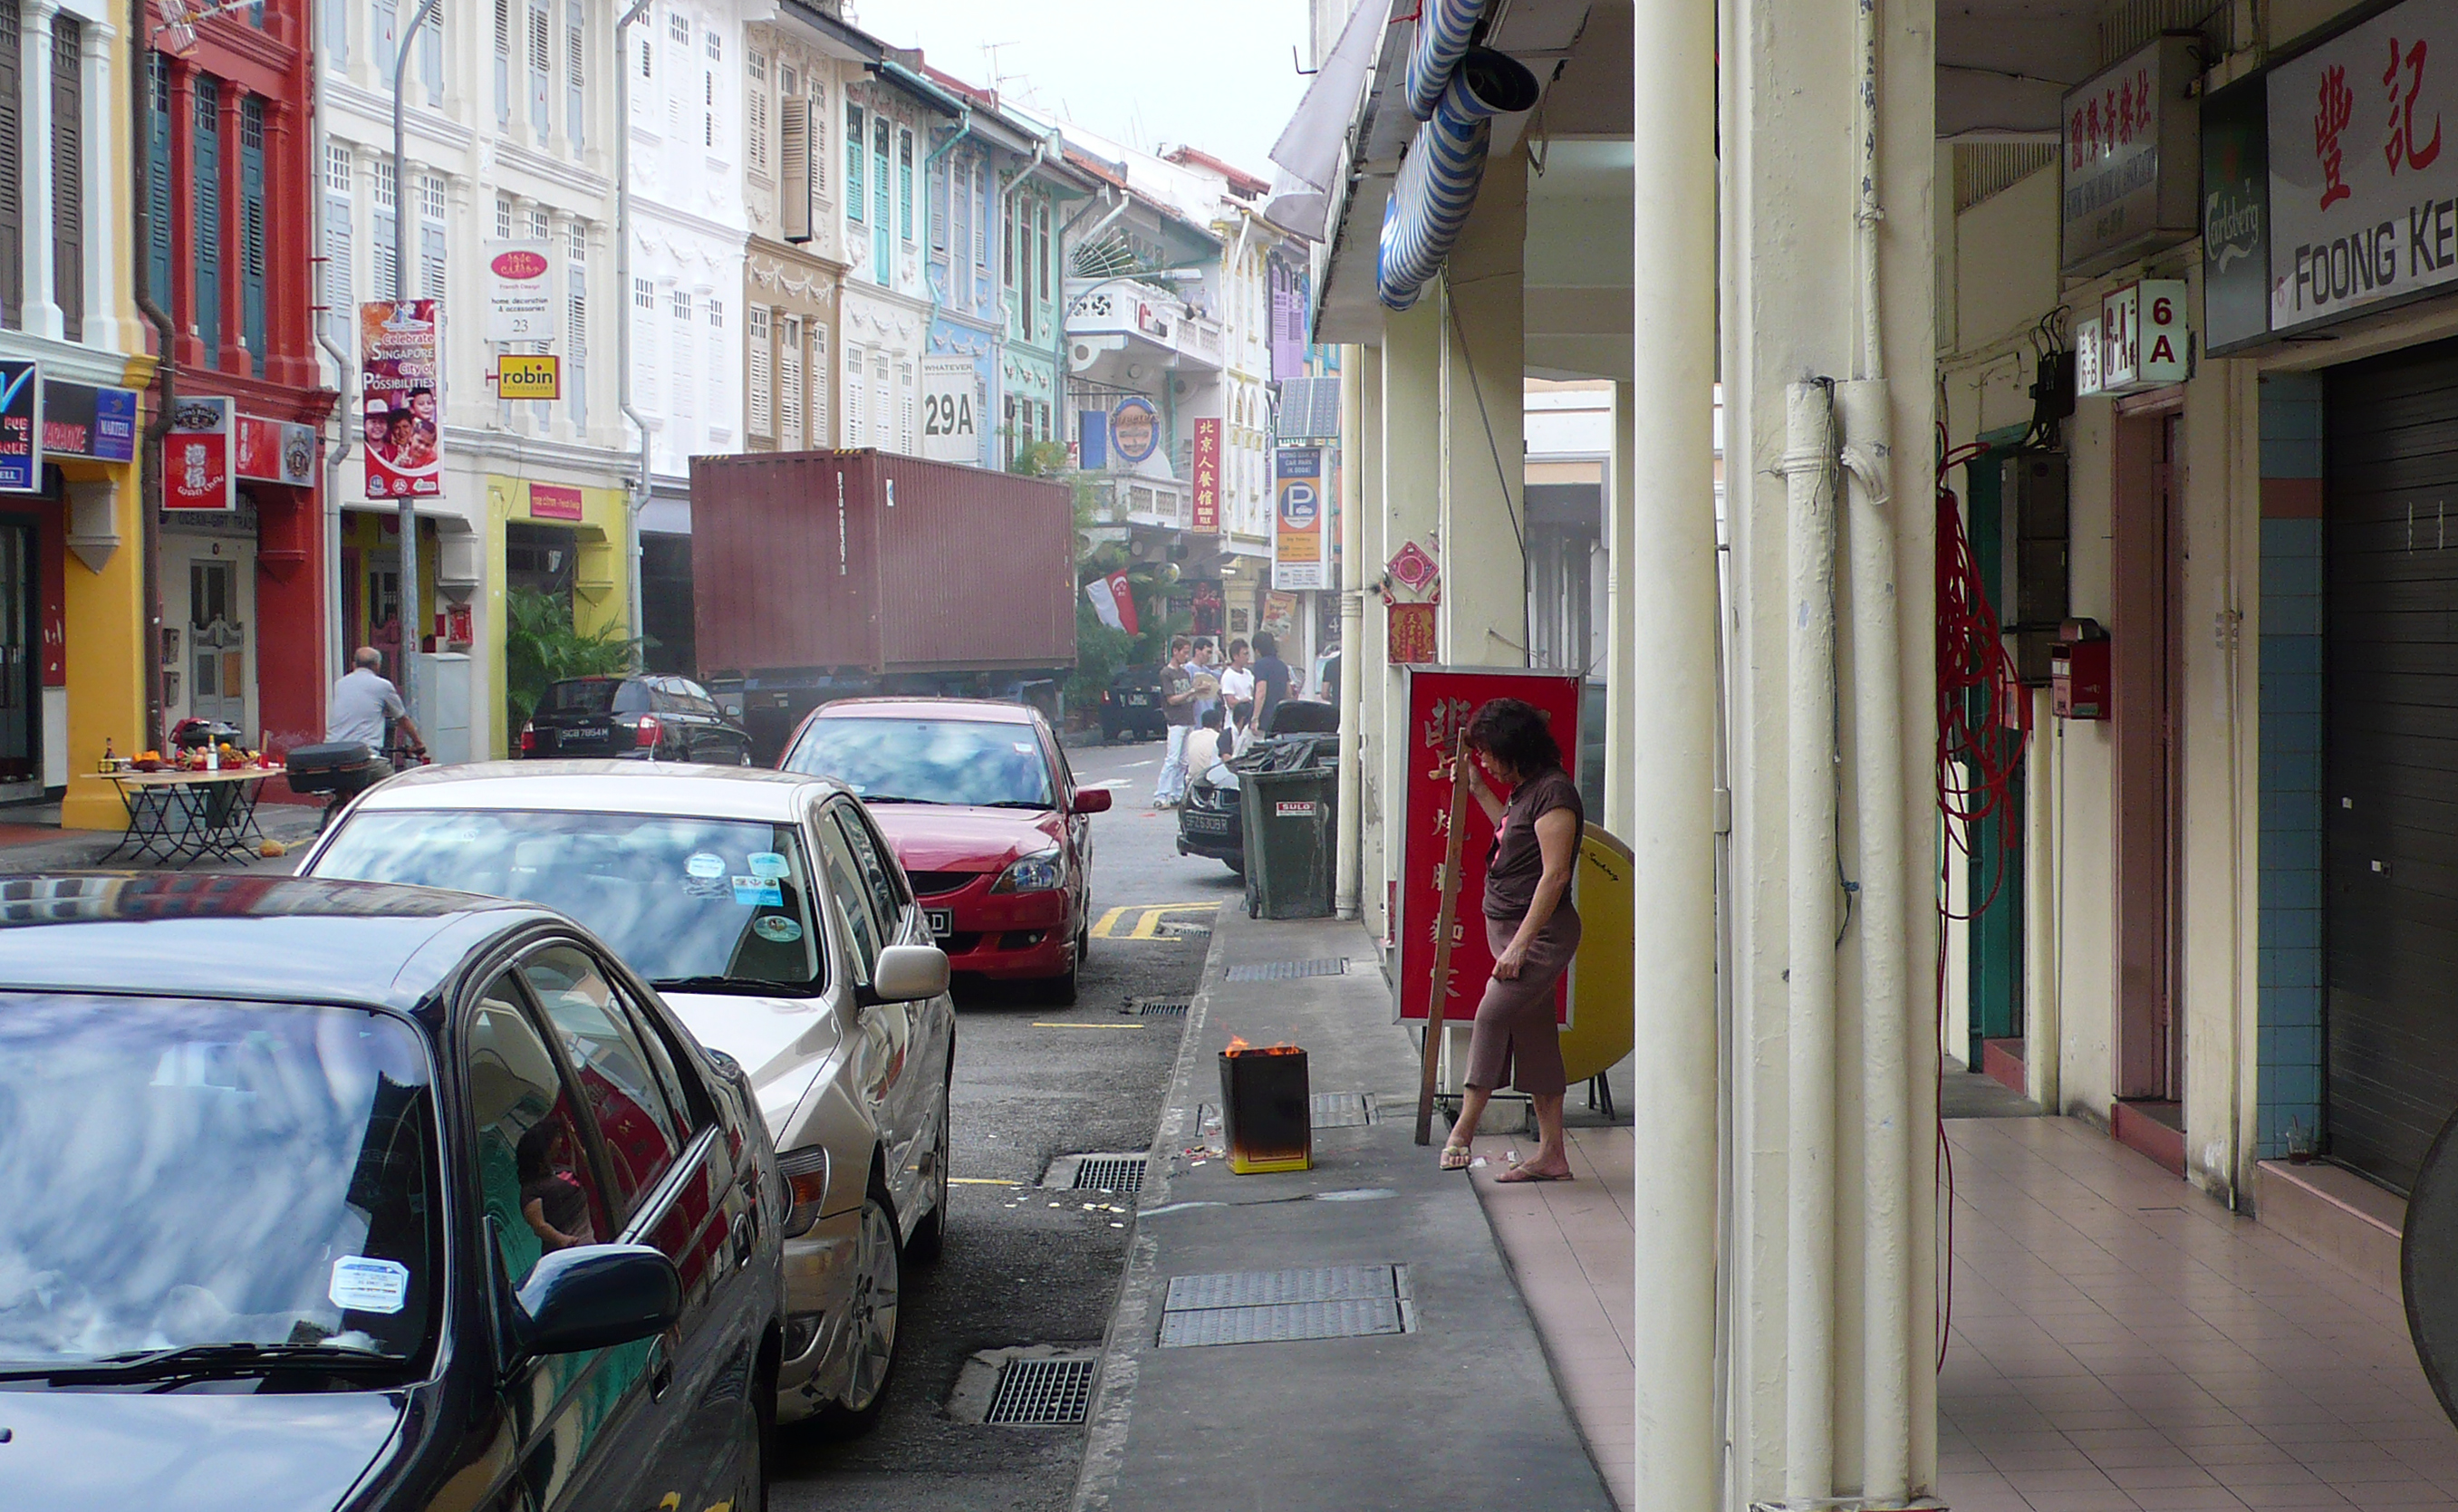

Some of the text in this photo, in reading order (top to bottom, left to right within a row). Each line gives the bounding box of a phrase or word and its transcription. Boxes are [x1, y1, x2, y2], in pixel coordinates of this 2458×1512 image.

[2205, 178, 2260, 263] Carlsberg
[2295, 196, 2458, 312] FOONG KE
[513, 319, 528, 332] 23
[2153, 297, 2173, 326] 6
[382, 333, 435, 344] Celebrate
[2149, 334, 2176, 363] A
[400, 363, 434, 376] City of
[504, 364, 553, 384] robin
[924, 393, 973, 436] 29A
